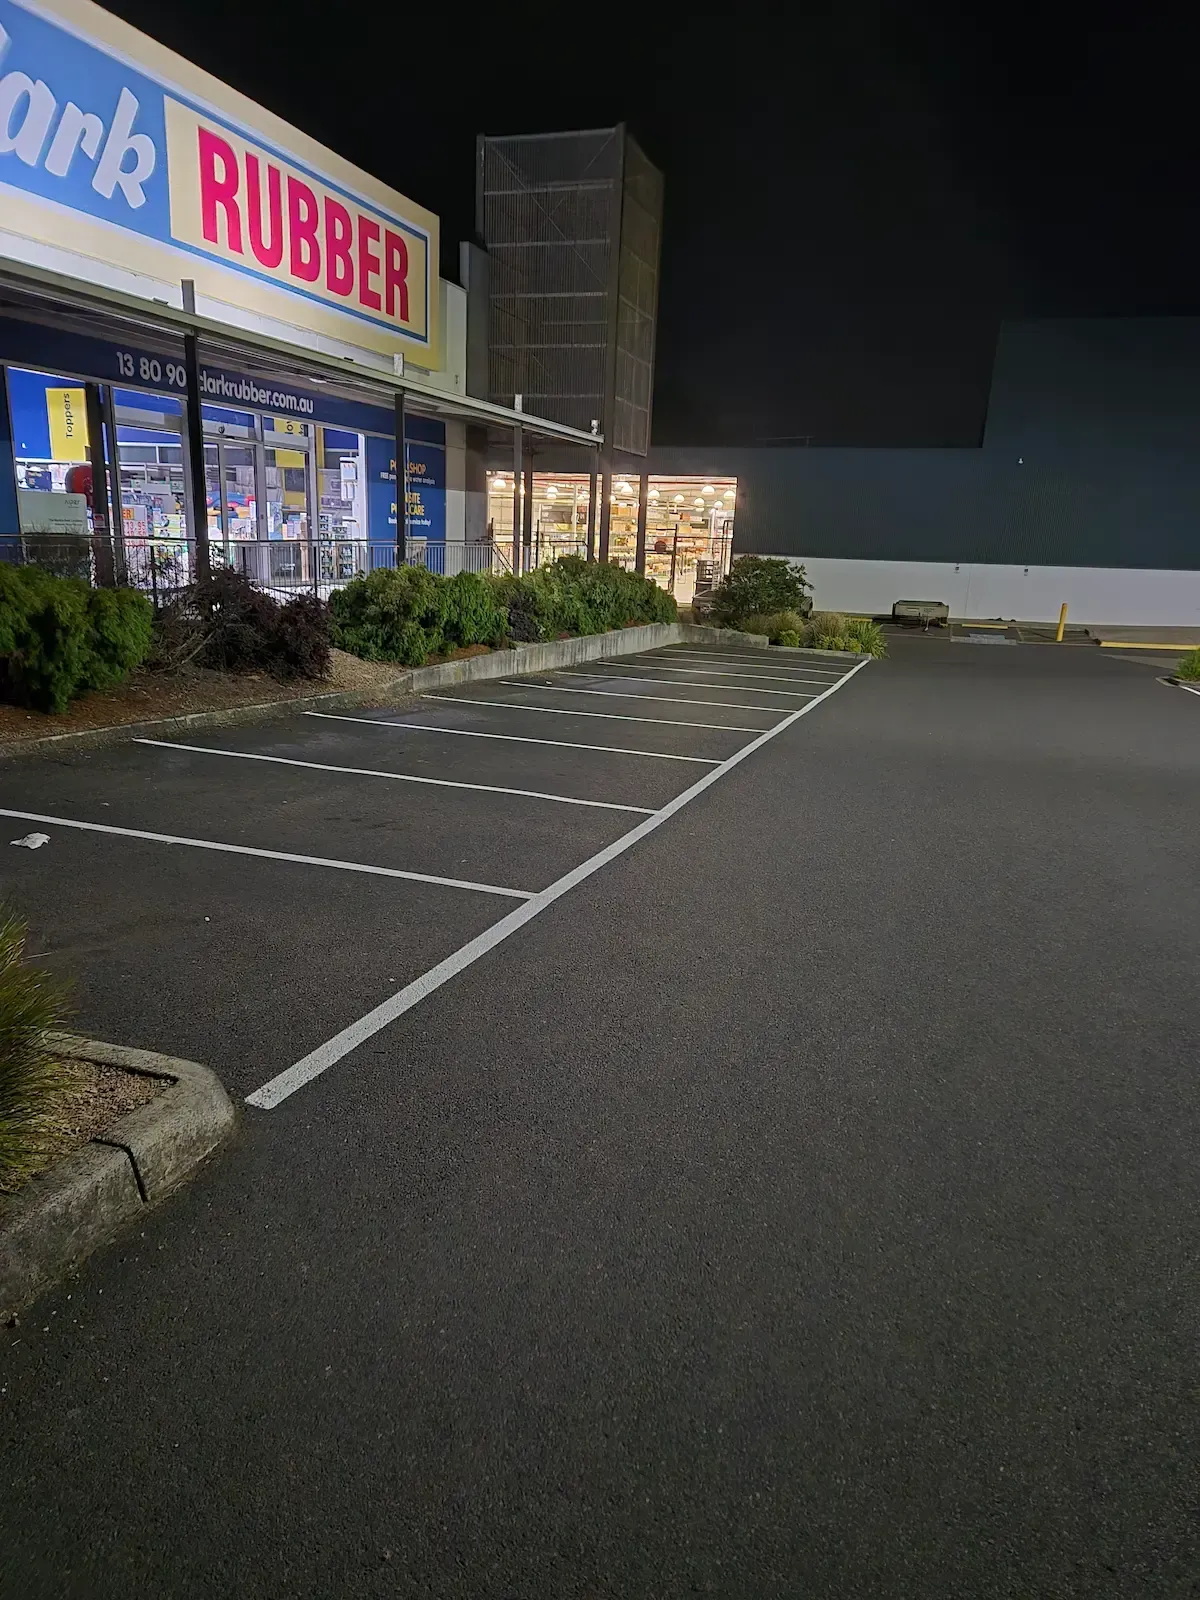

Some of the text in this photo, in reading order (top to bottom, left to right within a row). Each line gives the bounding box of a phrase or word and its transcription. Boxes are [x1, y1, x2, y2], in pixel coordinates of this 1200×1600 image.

[198, 124, 410, 323] RUBBER
[116, 351, 135, 377] 13
[139, 357, 162, 382] 80
[166, 363, 187, 388] 90
[64, 392, 74, 439] Toppers
[409, 462, 426, 475] SHOP
[409, 504, 425, 516] CARE
